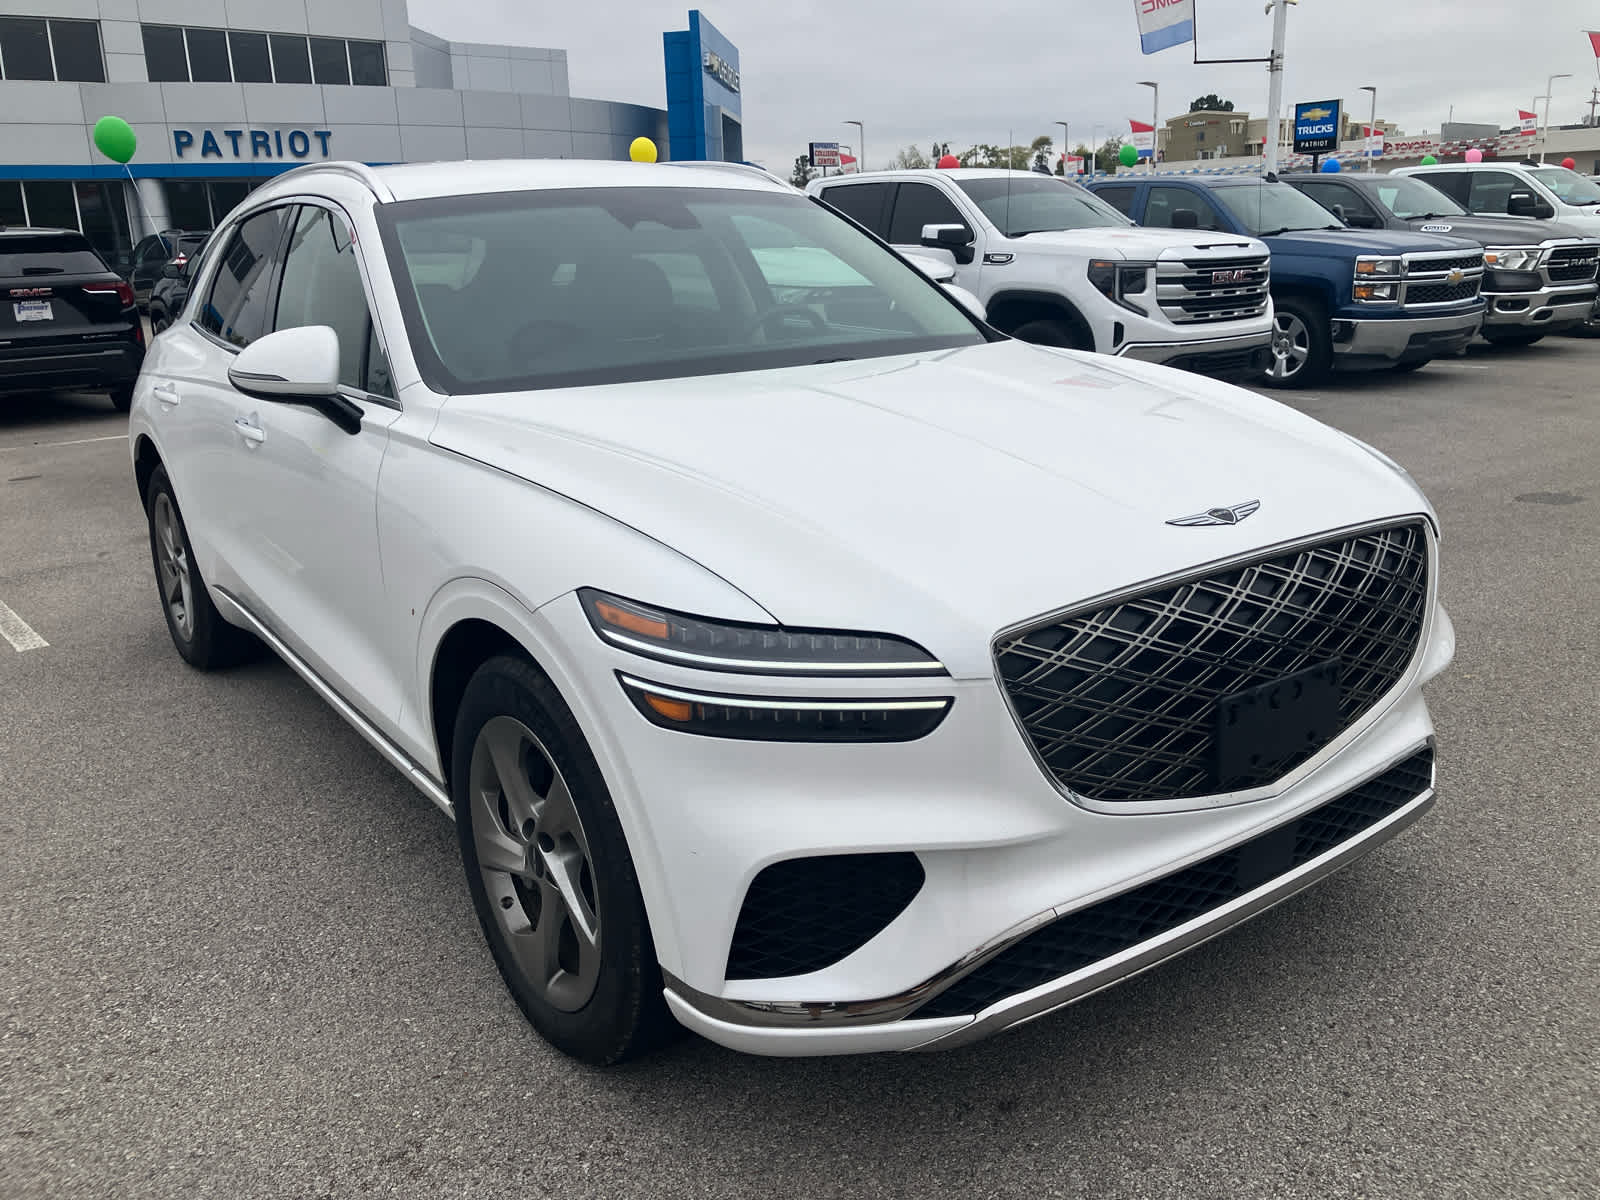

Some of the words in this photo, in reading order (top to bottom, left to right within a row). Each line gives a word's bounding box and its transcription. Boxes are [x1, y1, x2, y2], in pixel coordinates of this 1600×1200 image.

[1297, 124, 1334, 135] TRUCKS
[173, 129, 332, 158] PATRIOT
[1300, 140, 1329, 148] PATRIOT
[1394, 140, 1433, 152] TOYOTA
[1570, 258, 1594, 266] RAM
[1212, 269, 1253, 283] GMC
[9, 287, 53, 297] GMC
